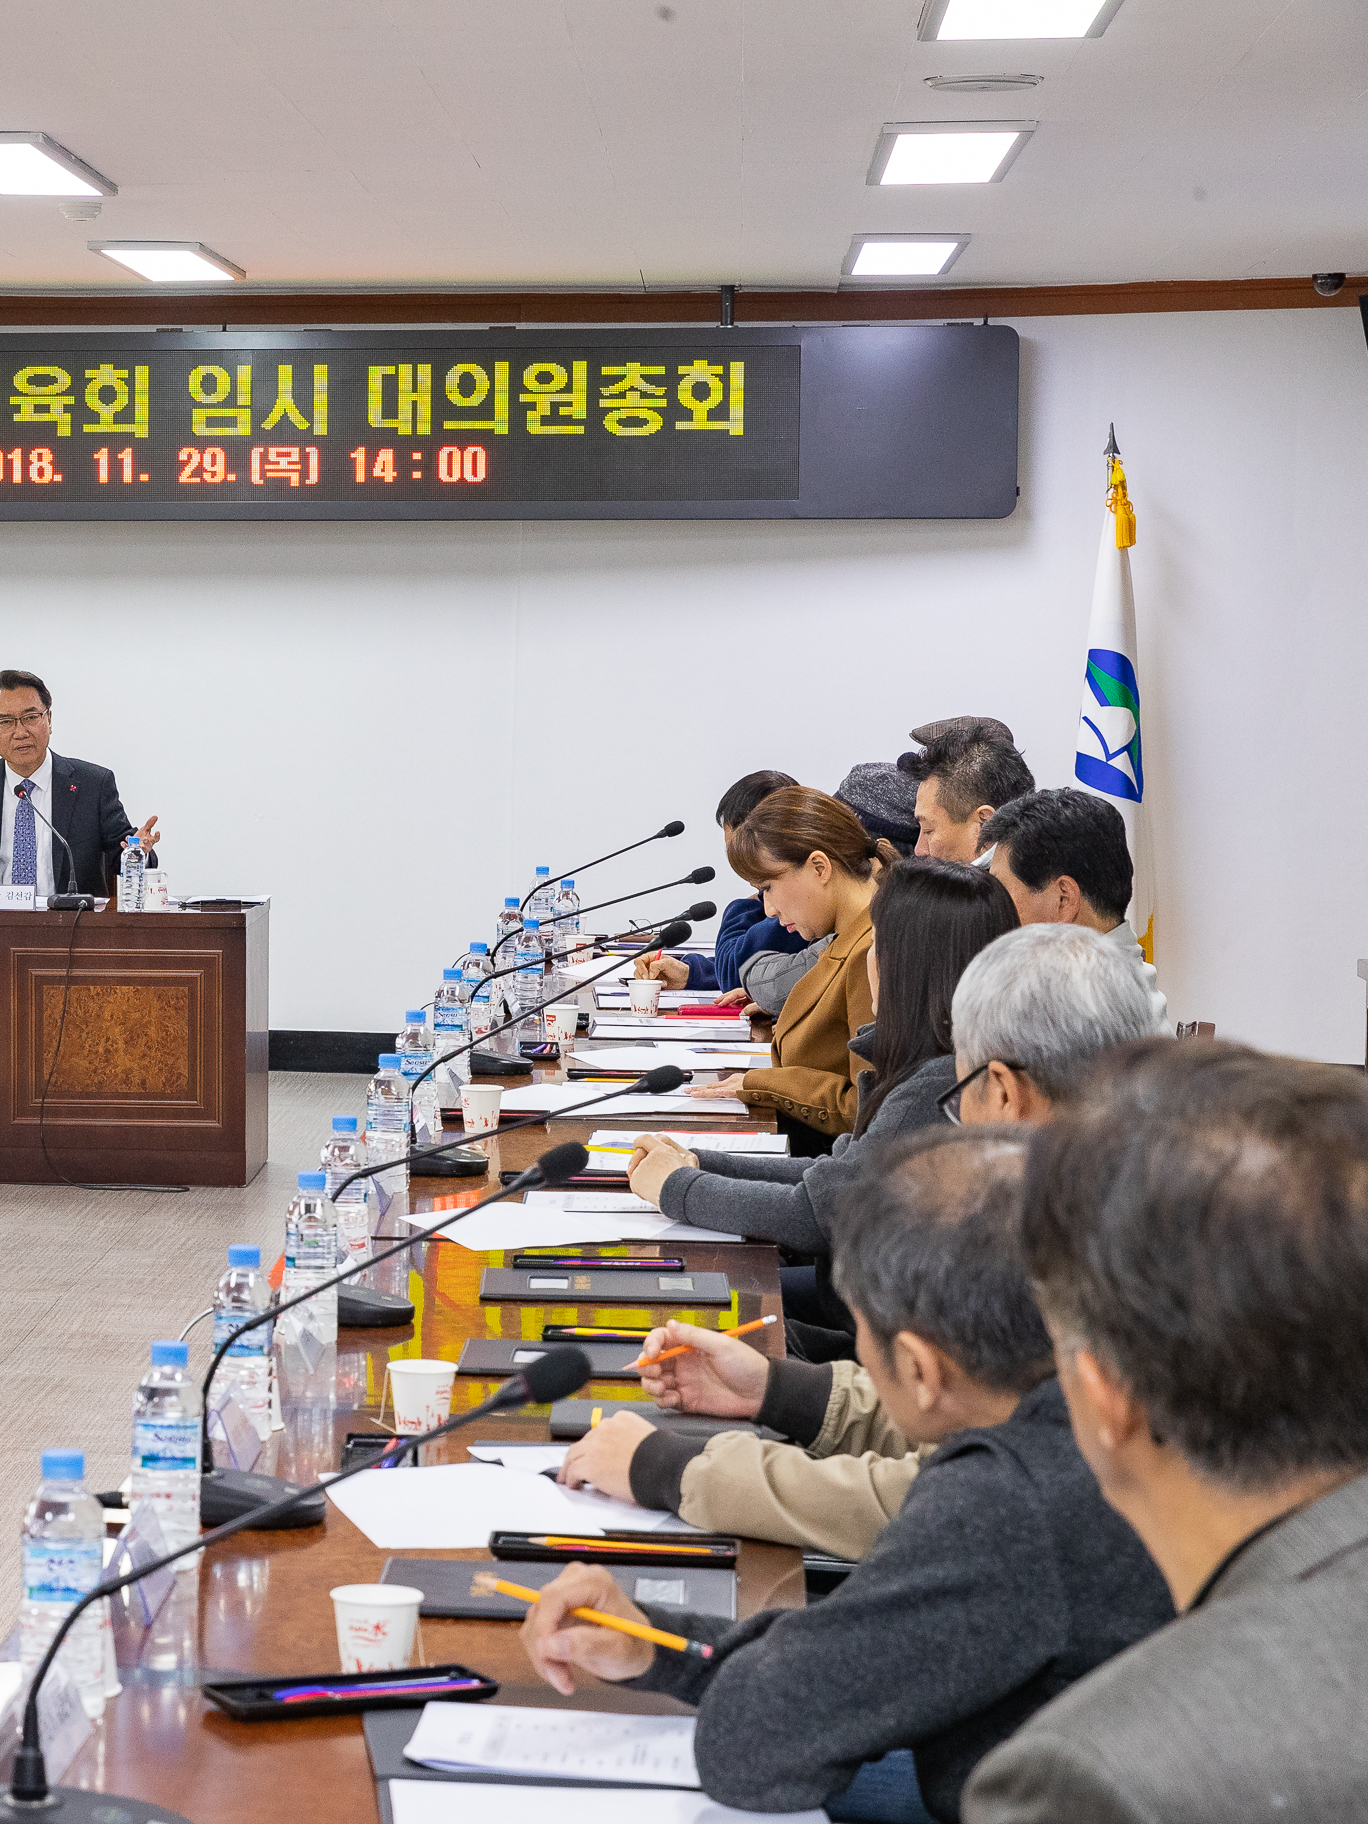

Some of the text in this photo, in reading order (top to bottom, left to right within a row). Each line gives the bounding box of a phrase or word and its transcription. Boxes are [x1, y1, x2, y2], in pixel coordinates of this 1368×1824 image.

[188, 364, 328, 438] 임시
[367, 360, 745, 437] 대의원총회
[93, 447, 150, 484] 11.
[5, 890, 33, 901] 김선갑
